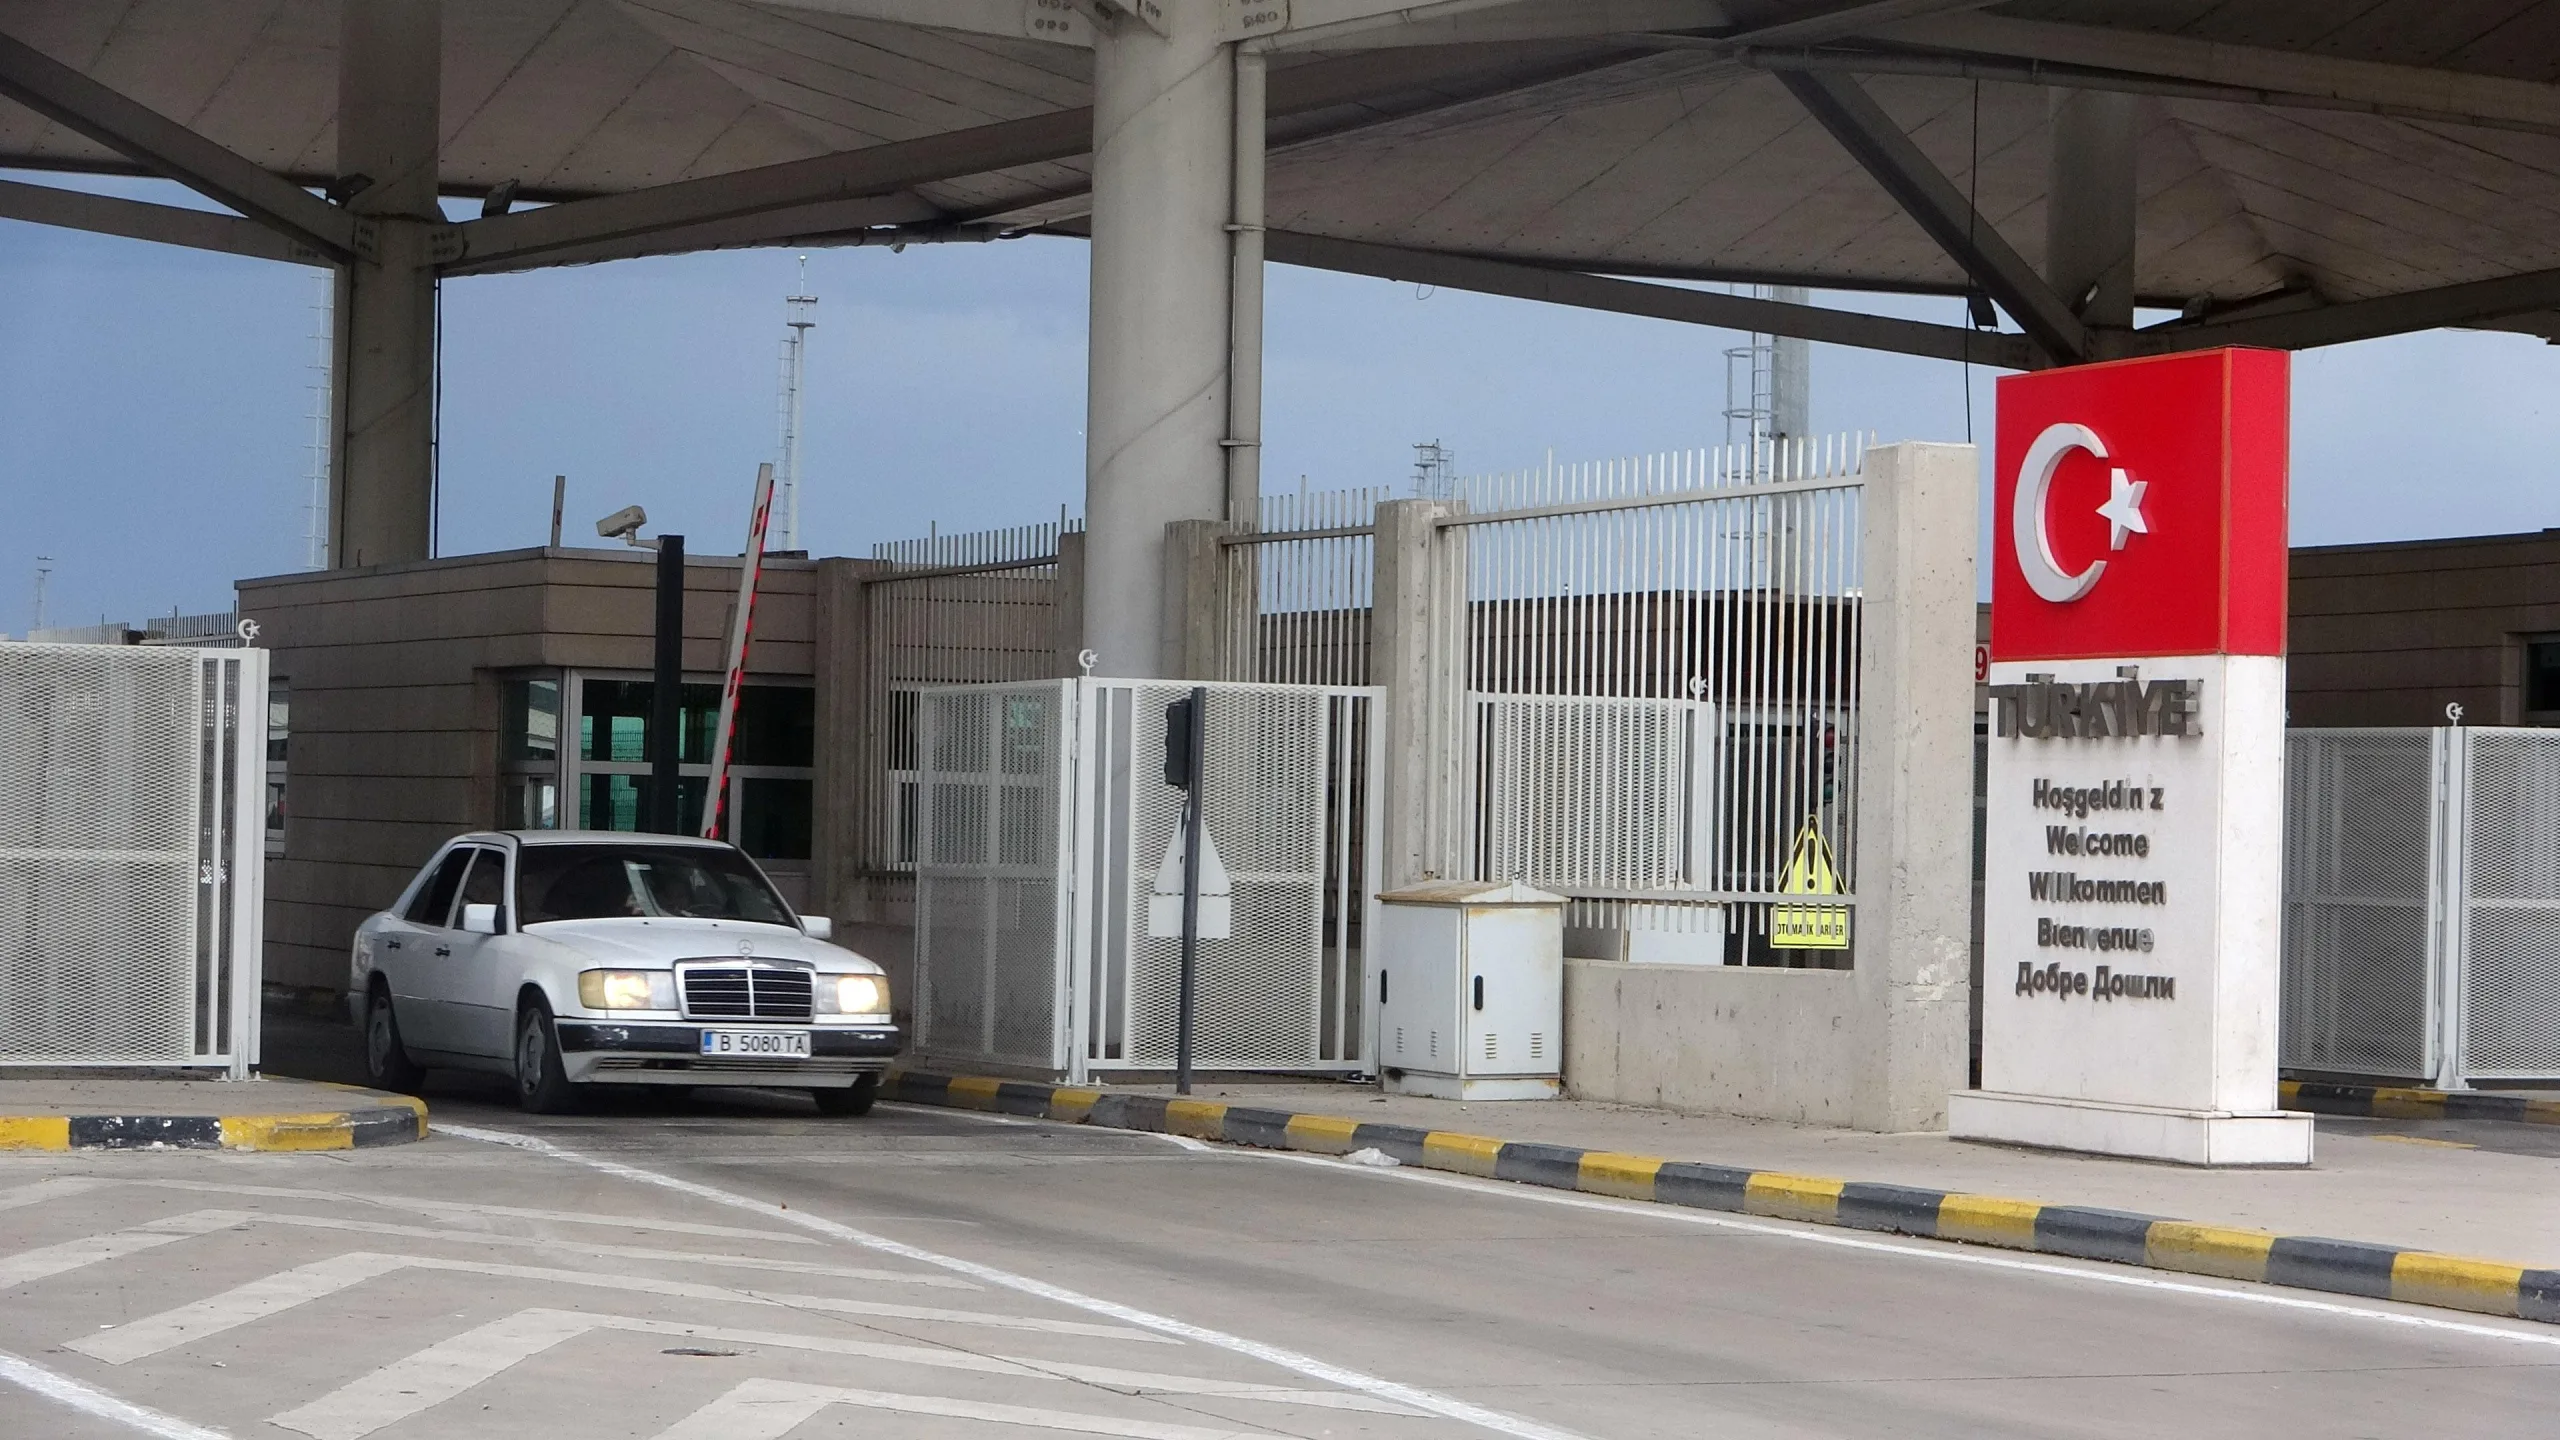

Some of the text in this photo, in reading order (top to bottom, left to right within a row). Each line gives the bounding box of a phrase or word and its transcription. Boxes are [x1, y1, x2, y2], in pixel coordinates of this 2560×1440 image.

[1989, 665, 2203, 738] TÜRKİYE
[2033, 776, 2164, 818] Hoşgeldinz
[2046, 825, 2150, 857] Welcome
[2029, 871, 2167, 905] Willkommen
[2037, 917, 2154, 953] Bienvenue
[2015, 961, 2176, 1002] Добре Дошли
[721, 1035, 805, 1053] B 5080 TA
